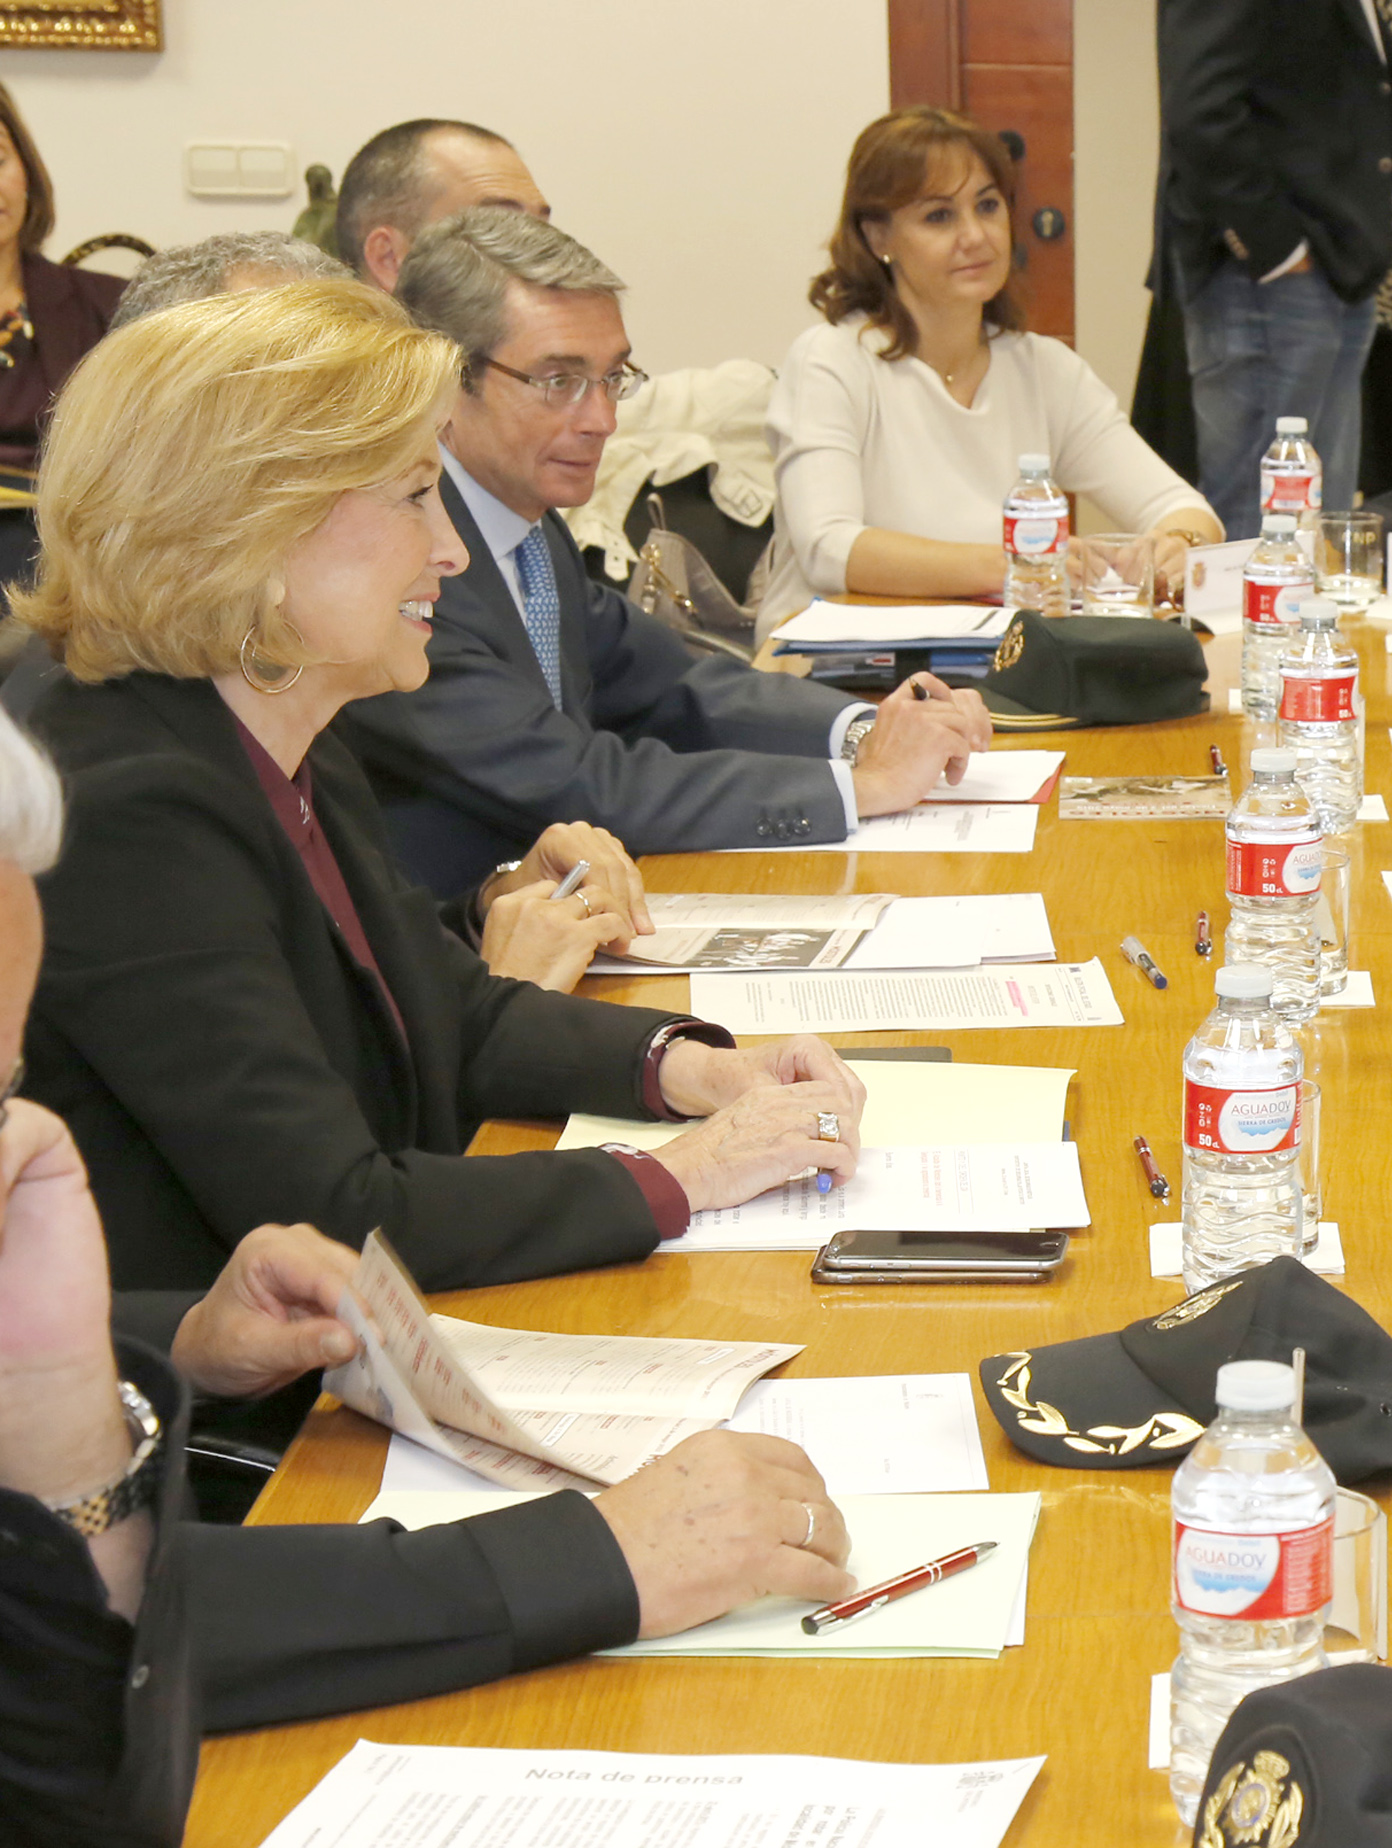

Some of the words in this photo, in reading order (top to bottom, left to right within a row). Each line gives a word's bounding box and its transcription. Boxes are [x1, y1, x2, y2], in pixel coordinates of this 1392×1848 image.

[1230, 1099, 1292, 1116] AGUADOY
[1186, 1545, 1268, 1569] AGUADOY
[524, 1768, 592, 1781] Nota
[600, 1771, 635, 1783] de
[643, 1774, 744, 1785] prensa
